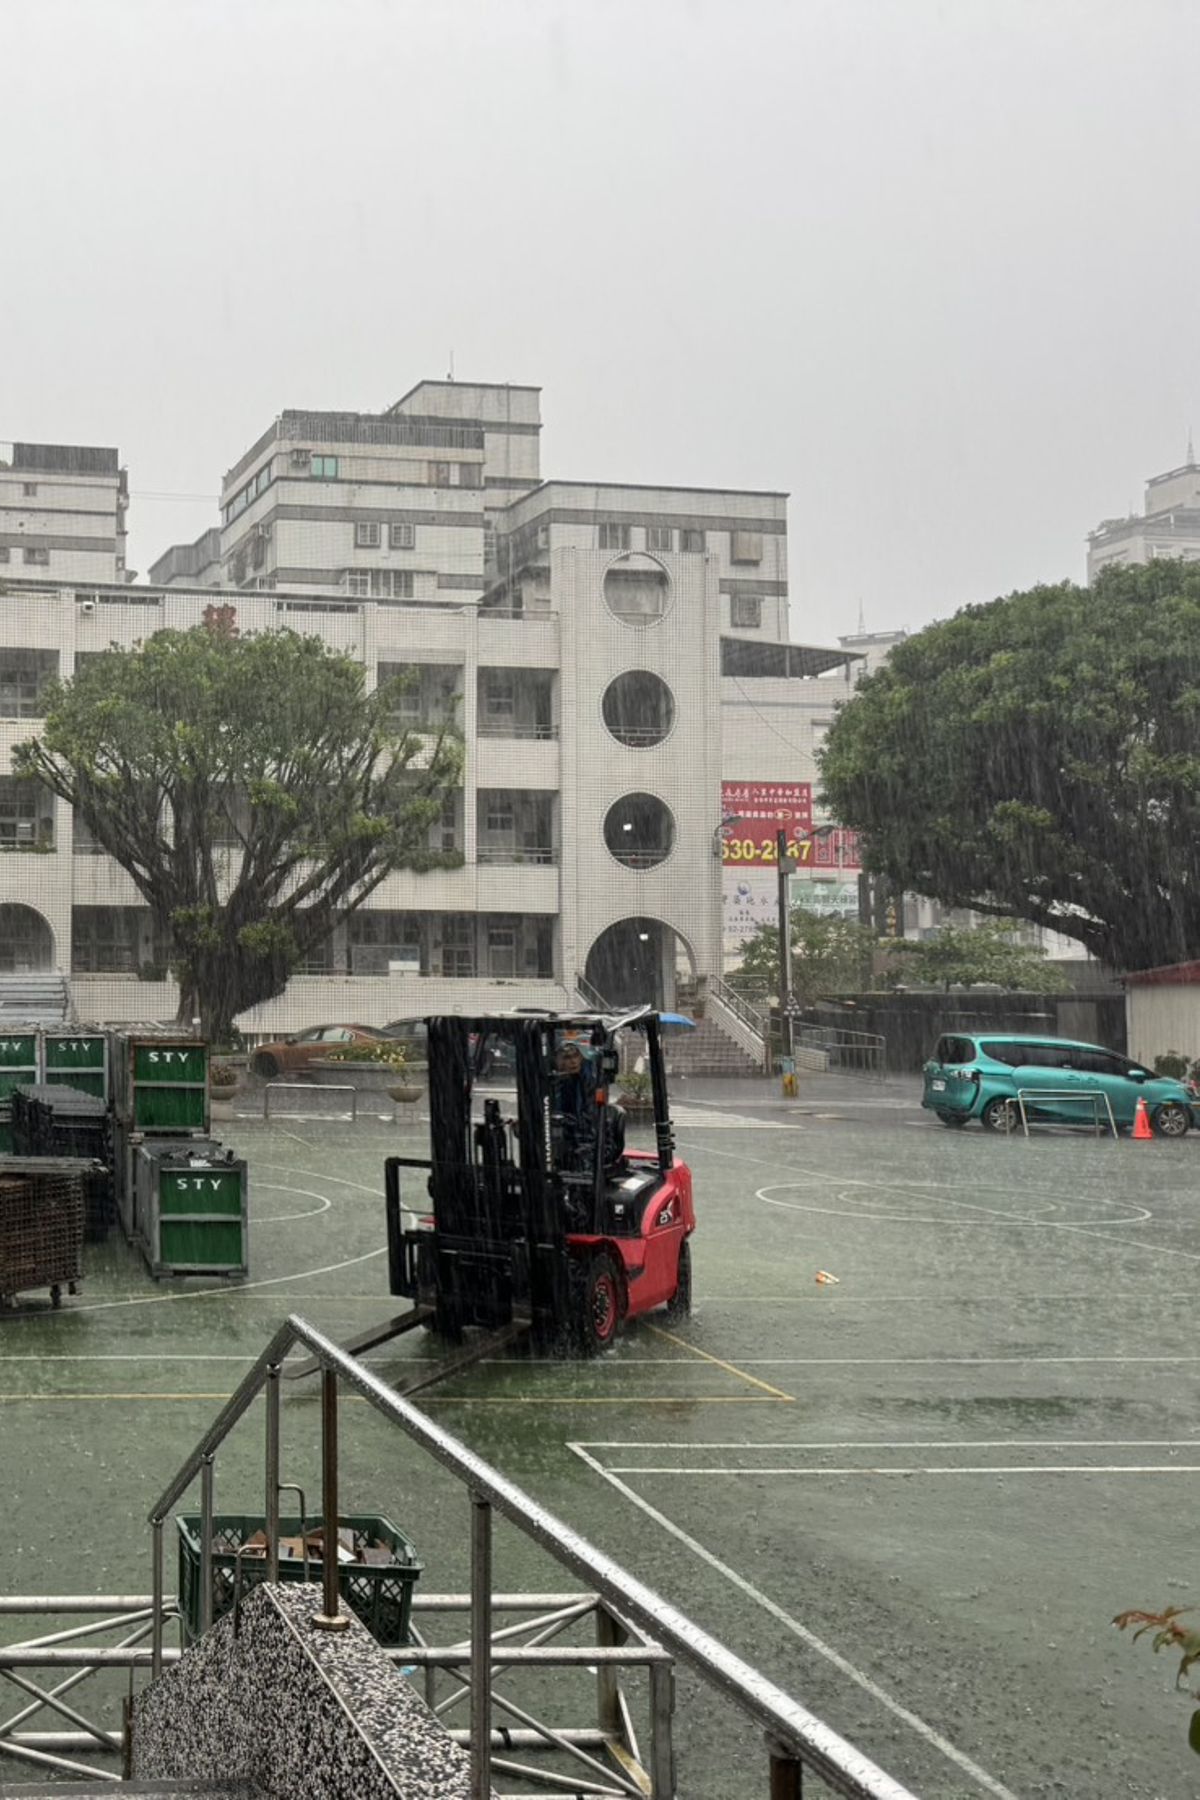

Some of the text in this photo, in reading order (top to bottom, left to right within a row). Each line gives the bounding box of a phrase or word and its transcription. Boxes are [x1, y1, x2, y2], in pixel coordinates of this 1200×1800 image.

[58, 1042, 91, 1052] STY
[148, 1051, 189, 1063] STY
[176, 1177, 222, 1190] STY
